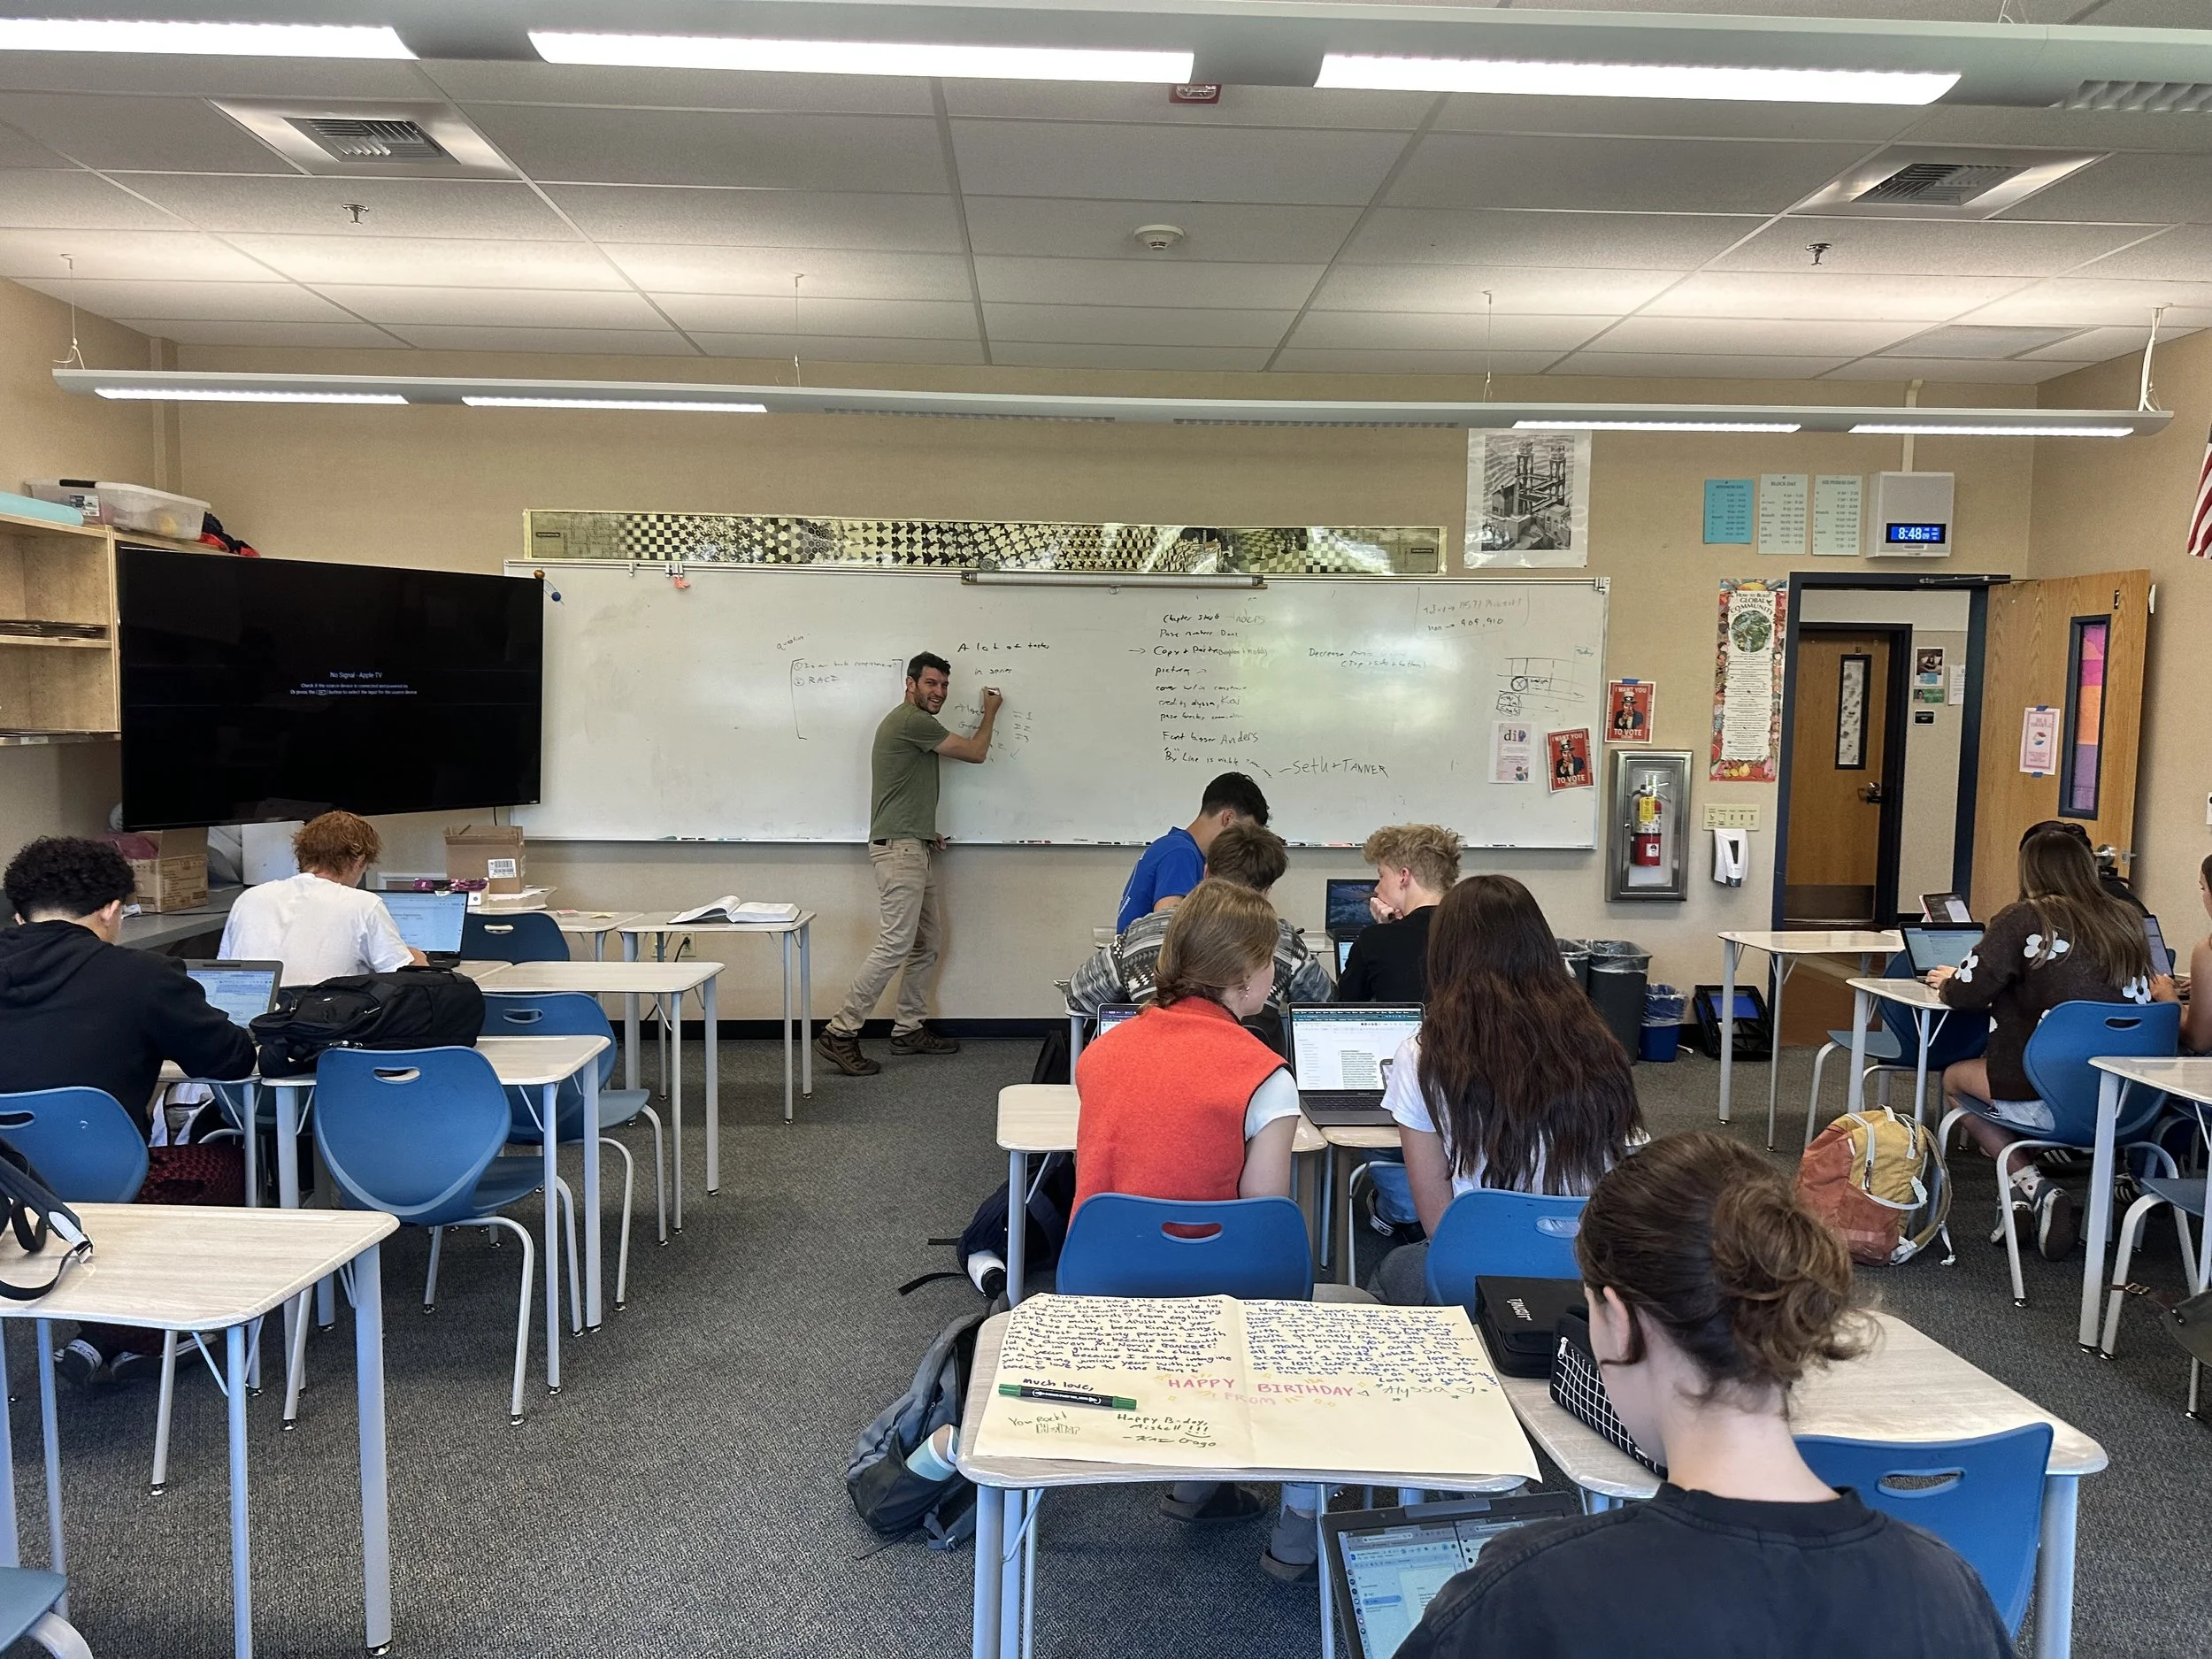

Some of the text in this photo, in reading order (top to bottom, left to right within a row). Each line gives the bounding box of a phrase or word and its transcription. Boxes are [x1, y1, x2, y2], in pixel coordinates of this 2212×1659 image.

[1898, 527, 1922, 540] 8:48
[1730, 603, 1774, 615] COMMUNITY
[957, 642, 970, 653] A
[1220, 730, 1259, 745] Anders
[1292, 756, 1328, 775] Seth
[1341, 758, 1390, 779] TANNER
[1567, 774, 1586, 783] VOTE
[1022, 1377, 1094, 1392] much love,
[1168, 1378, 1356, 1398] HAPPY BIRTHDAY
[1382, 1385, 1451, 1398] Alyssa
[1225, 1392, 1277, 1406] FROM
[1117, 1413, 1158, 1425] Happy
